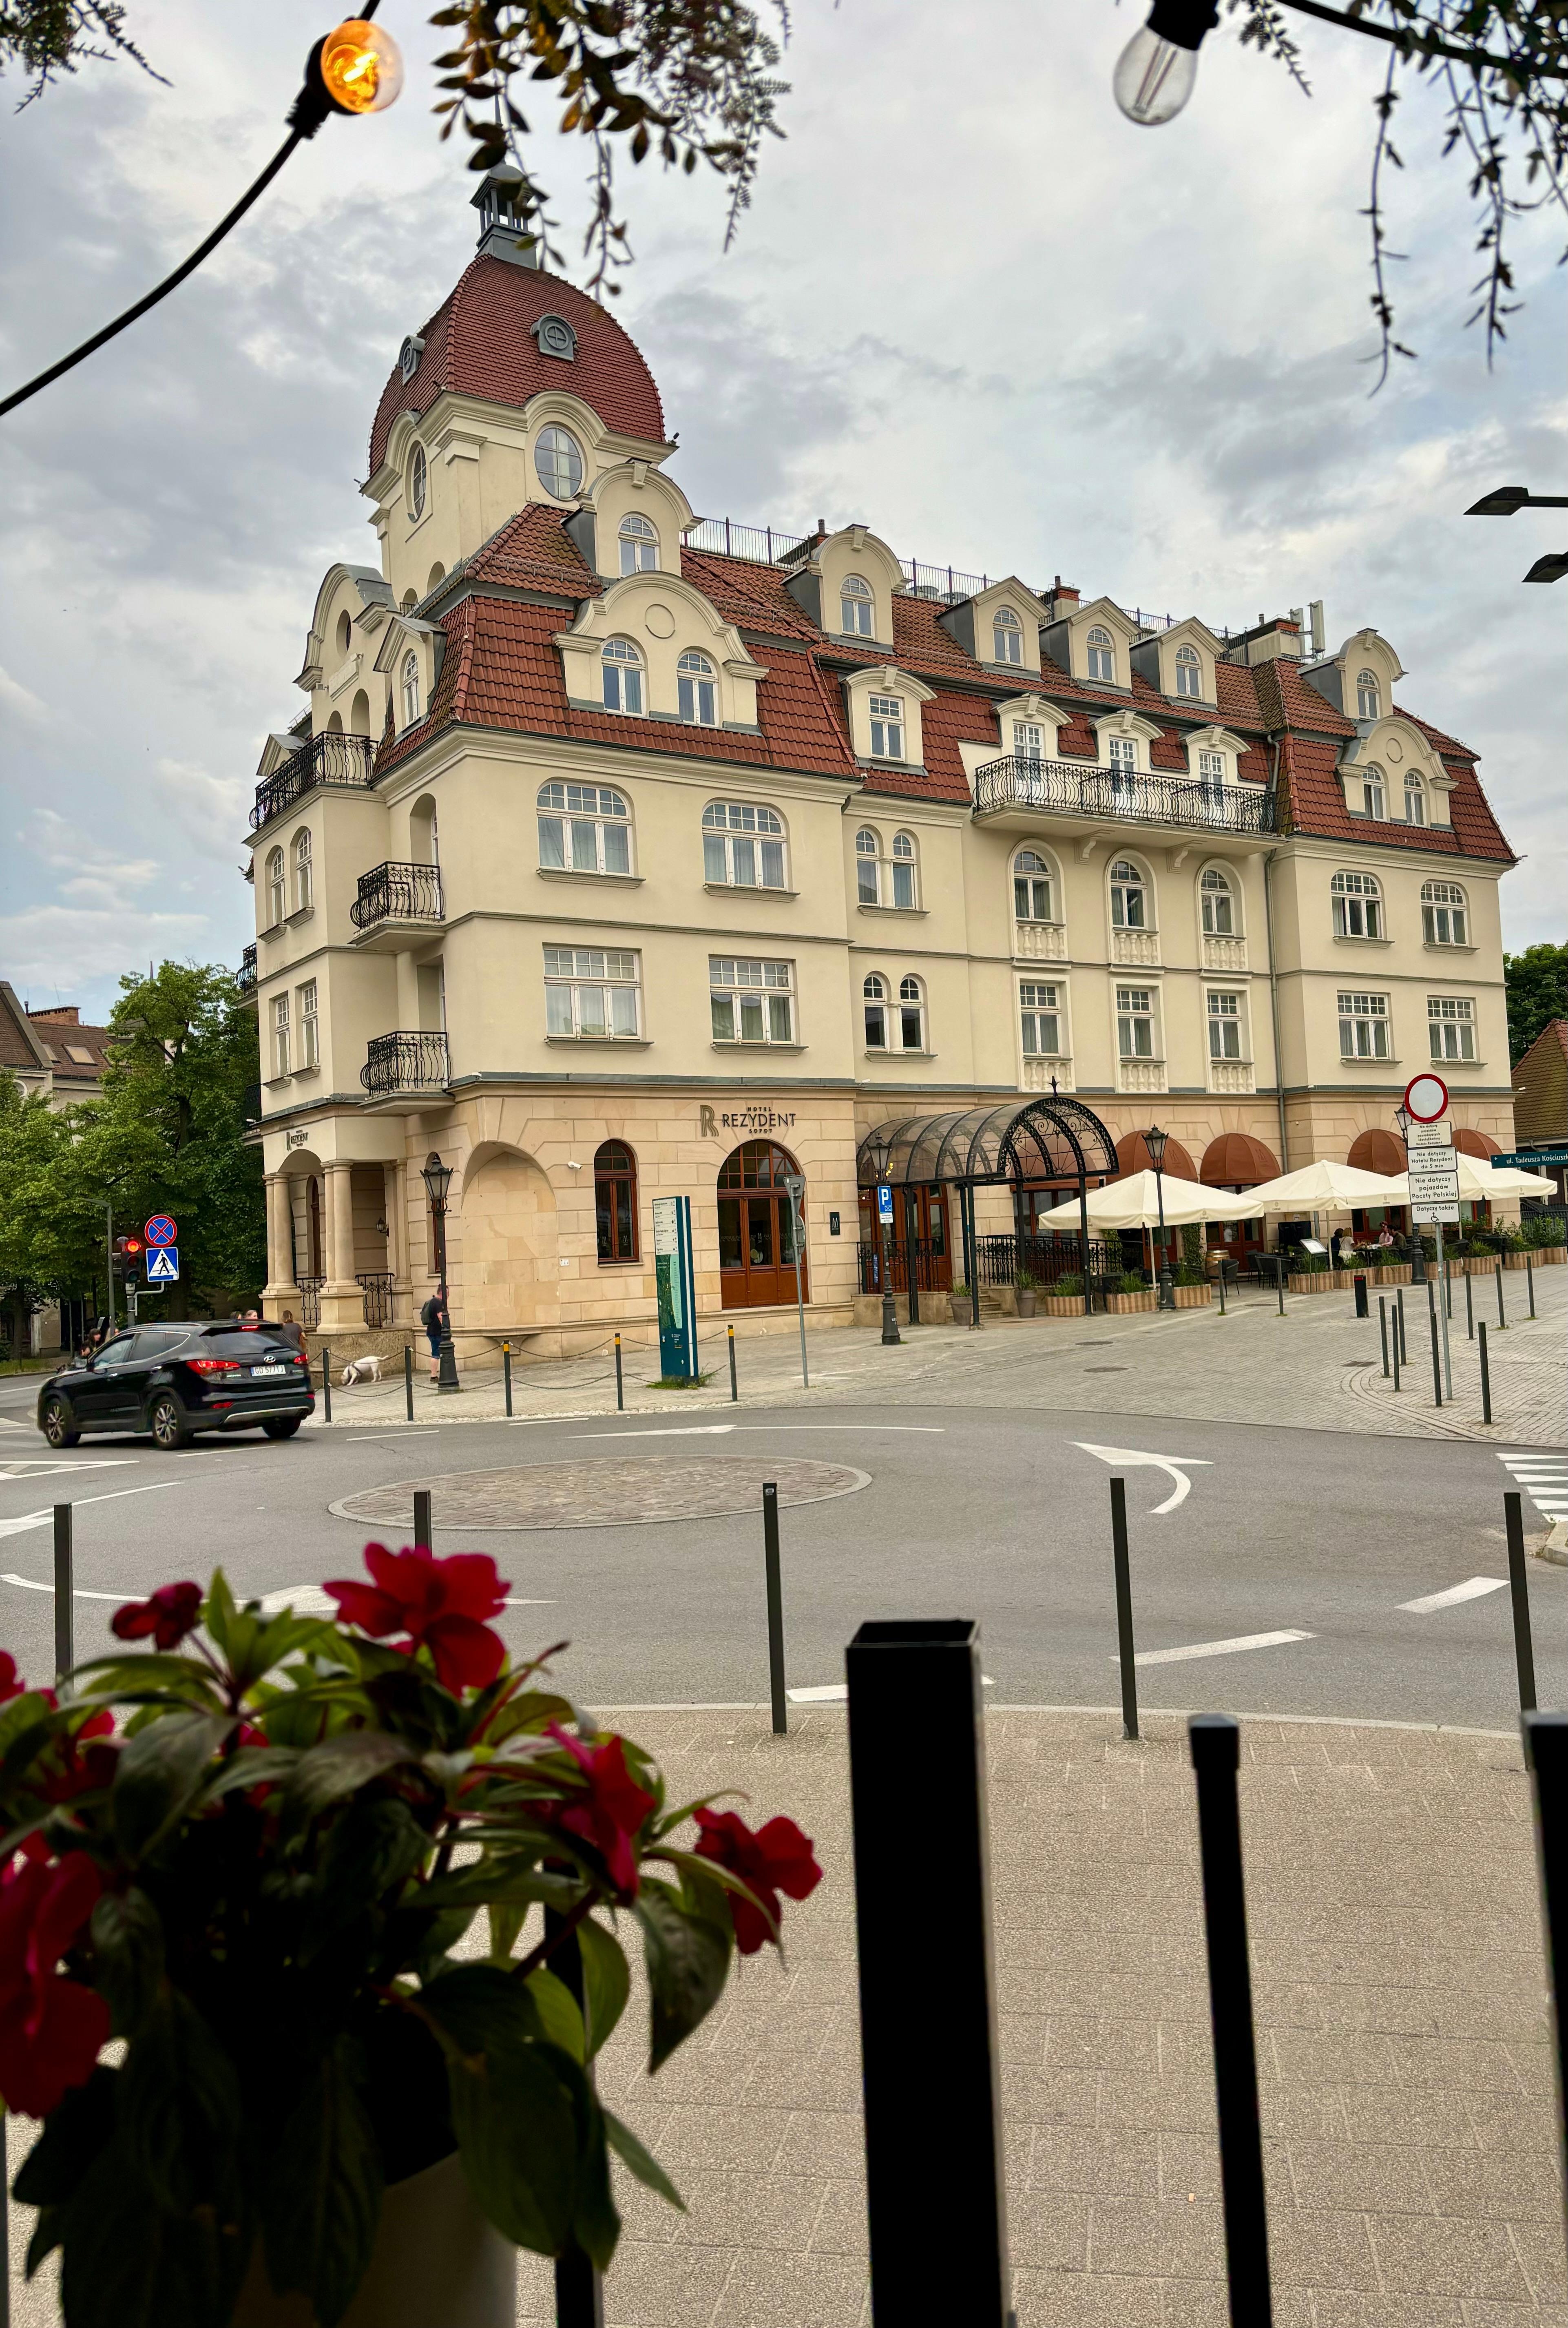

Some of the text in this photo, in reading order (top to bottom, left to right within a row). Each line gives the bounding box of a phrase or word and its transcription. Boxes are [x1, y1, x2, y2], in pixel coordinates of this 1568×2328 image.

[722, 1113, 796, 1127] REZYDENT
[1419, 1184, 1448, 1192] pojazdów
[881, 1189, 889, 1206] P
